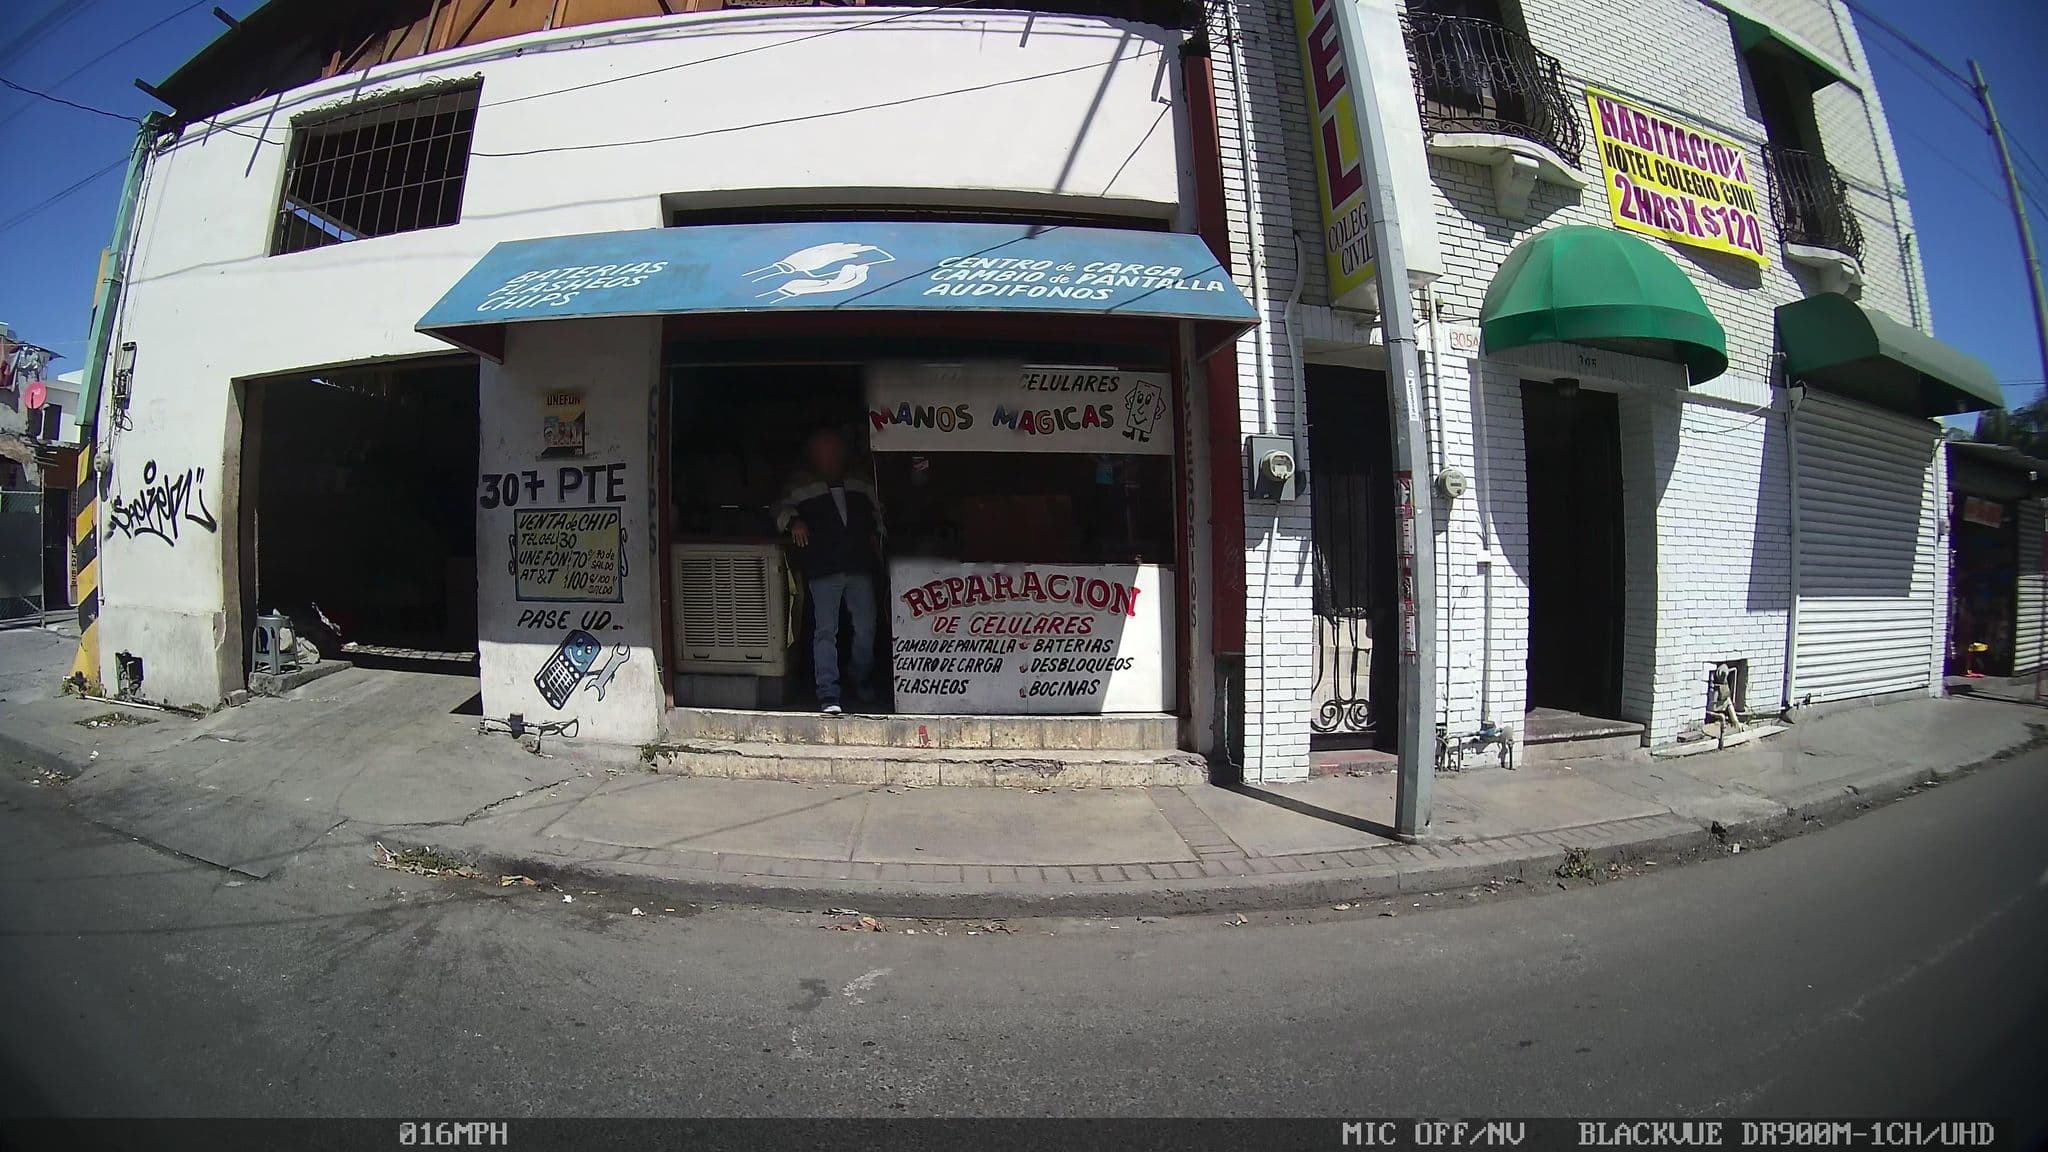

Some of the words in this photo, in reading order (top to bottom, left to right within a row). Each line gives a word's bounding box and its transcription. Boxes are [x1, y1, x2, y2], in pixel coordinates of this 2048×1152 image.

[1603, 141, 1654, 181] HOTEL
[1654, 159, 1720, 202] COLEGIO
[1329, 201, 1369, 252] COLEG
[1342, 233, 1374, 275] CIVIL
[506, 261, 669, 285] BATERIAS
[938, 256, 1054, 271] CENTRO
[1055, 262, 1076, 272] de
[1083, 261, 1184, 277] CARGA
[488, 275, 649, 297] FLASHEOS
[930, 268, 1046, 283] CAMBIO
[1049, 273, 1071, 284] de
[1075, 273, 1226, 292] PANTALLA
[477, 291, 580, 312] CHIPS
[923, 283, 1114, 300] AUDIFONOS
[869, 402, 974, 432] MANOS
[992, 404, 1115, 435] MAGICAS
[480, 470, 545, 510] 307
[560, 463, 627, 503] PTE
[519, 513, 568, 530] VENTA
[578, 513, 618, 531] CHIP
[902, 571, 1141, 617] REPARACION
[517, 609, 571, 630] PASE
[933, 615, 961, 634] DE
[969, 615, 1095, 635] CELULARES
[896, 639, 942, 653] CAMBIO
[956, 639, 1017, 654] PANTALLA
[1032, 638, 1115, 653] BATERIAS
[896, 657, 940, 672] CENTRO
[955, 657, 1004, 673] CARGA
[1030, 657, 1134, 674] DESBLOQUEOS
[896, 678, 970, 695] FLASHEOS
[1029, 679, 1101, 697] BOCINAS
